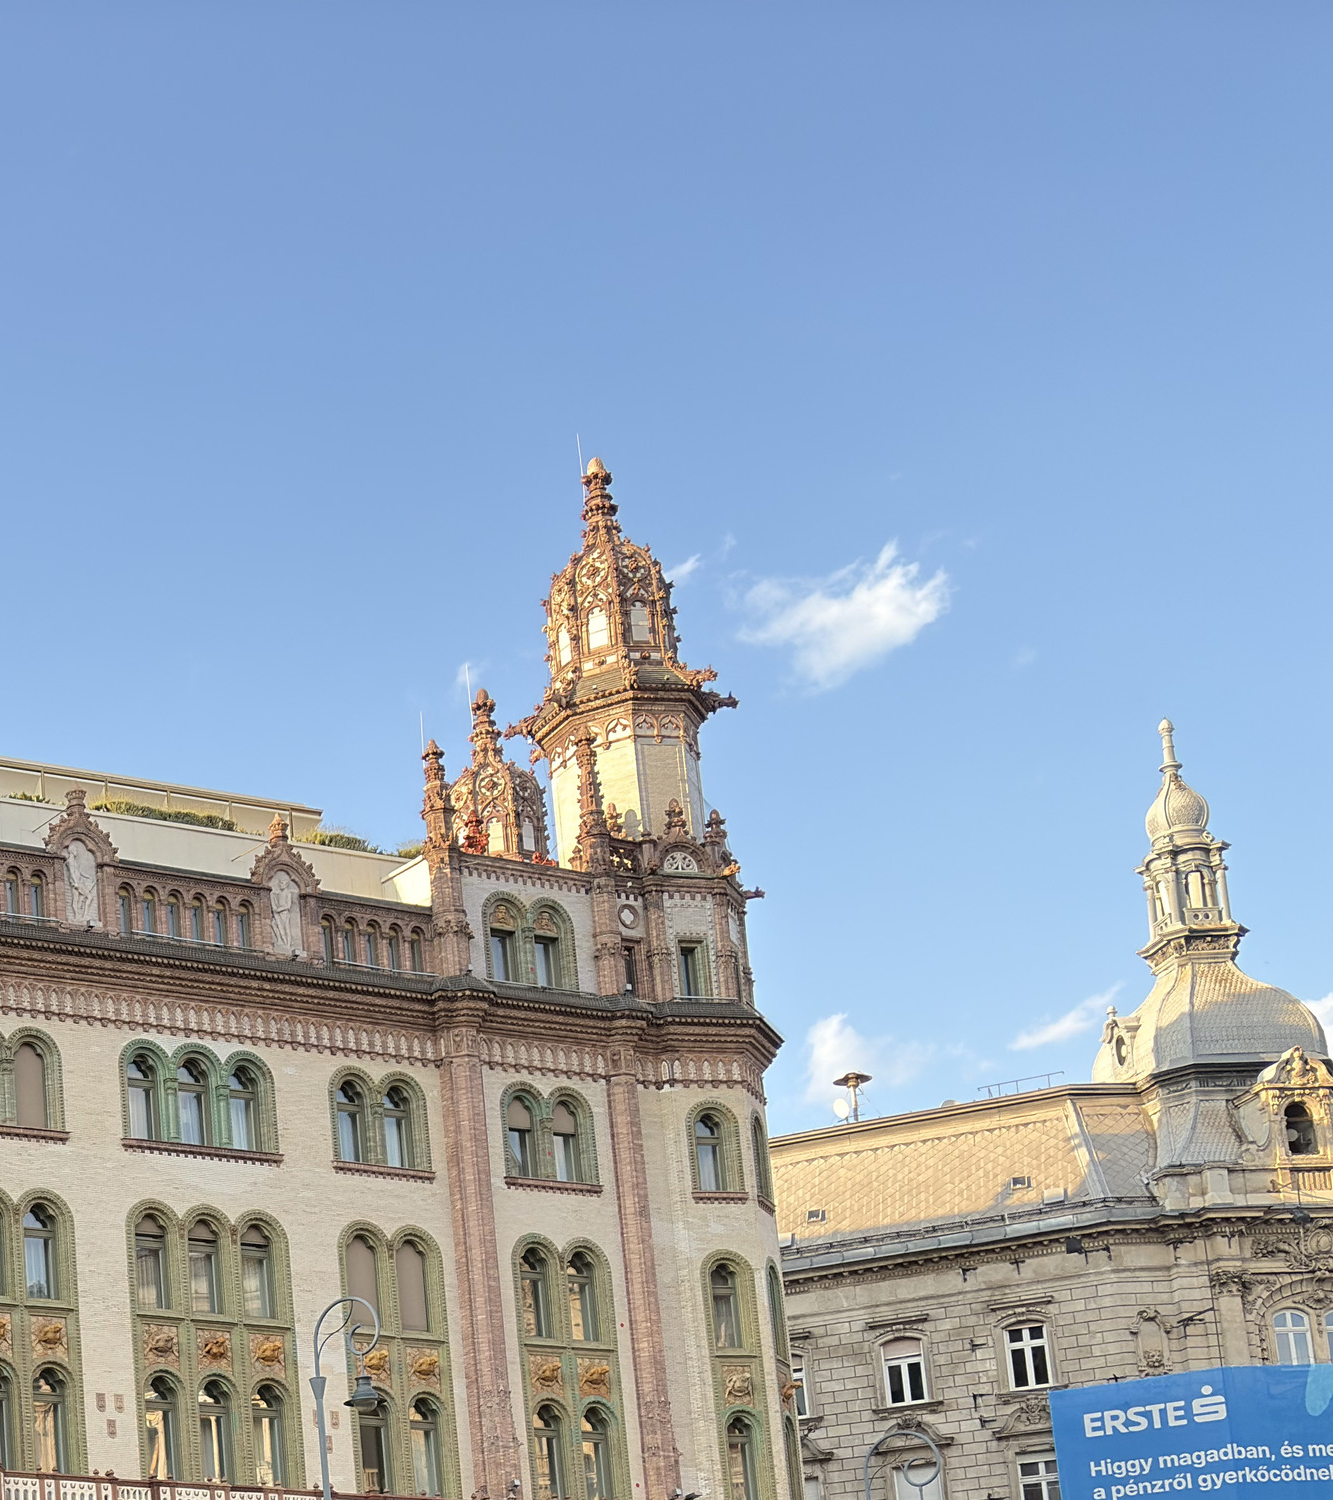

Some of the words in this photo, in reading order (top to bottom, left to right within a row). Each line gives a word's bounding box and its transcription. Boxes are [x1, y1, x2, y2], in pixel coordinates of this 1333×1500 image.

[1083, 1400, 1188, 1438] ERSTE
[1090, 1456, 1152, 1479] Higgy
[1158, 1443, 1276, 1468] magadban,
[1280, 1440, 1304, 1458] és
[1093, 1485, 1106, 1500] a
